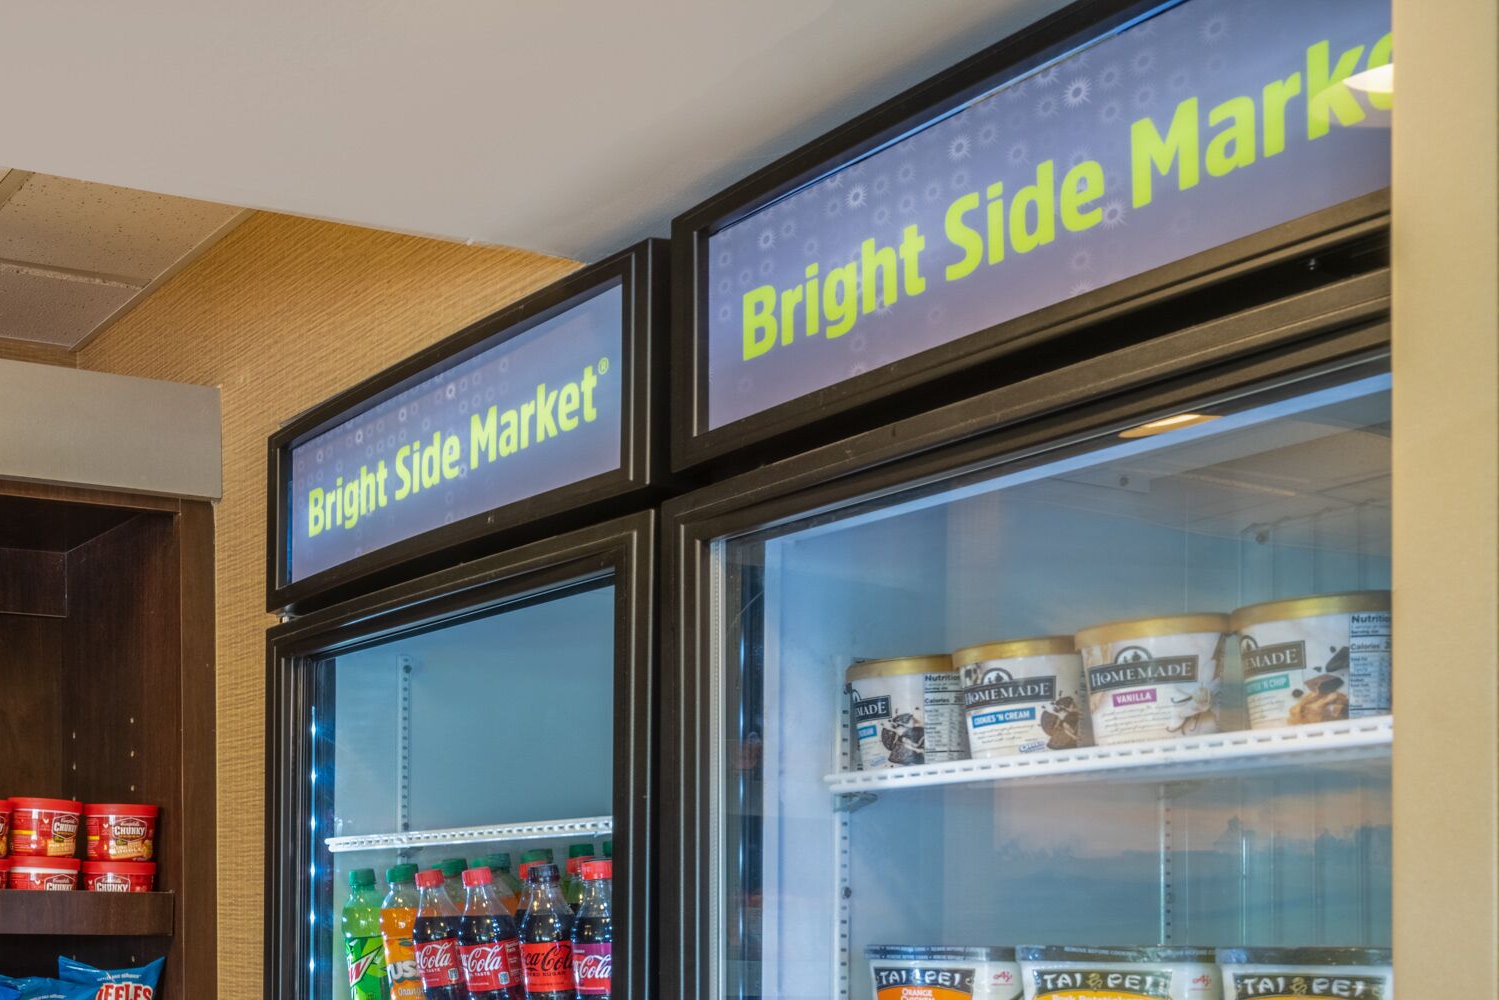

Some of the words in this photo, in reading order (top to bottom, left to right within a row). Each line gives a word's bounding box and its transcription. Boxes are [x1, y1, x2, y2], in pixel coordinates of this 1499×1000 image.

[743, 224, 926, 361] Bright
[945, 159, 1105, 282] Side
[308, 460, 388, 538] Bright
[395, 431, 460, 501] Side
[1091, 662, 1192, 688] HOMEMADE
[1116, 693, 1151, 704] VANILLA
[114, 826, 145, 836] CHUNKY
[96, 882, 129, 892] CHUNKY
[881, 970, 907, 983] TAI
[925, 970, 961, 985] PEI
[1043, 974, 1083, 989] TAI
[1107, 974, 1152, 992] PEI
[901, 989, 933, 997] ORANGE
[1242, 977, 1284, 995] TAI
[1312, 978, 1364, 996] PEI
